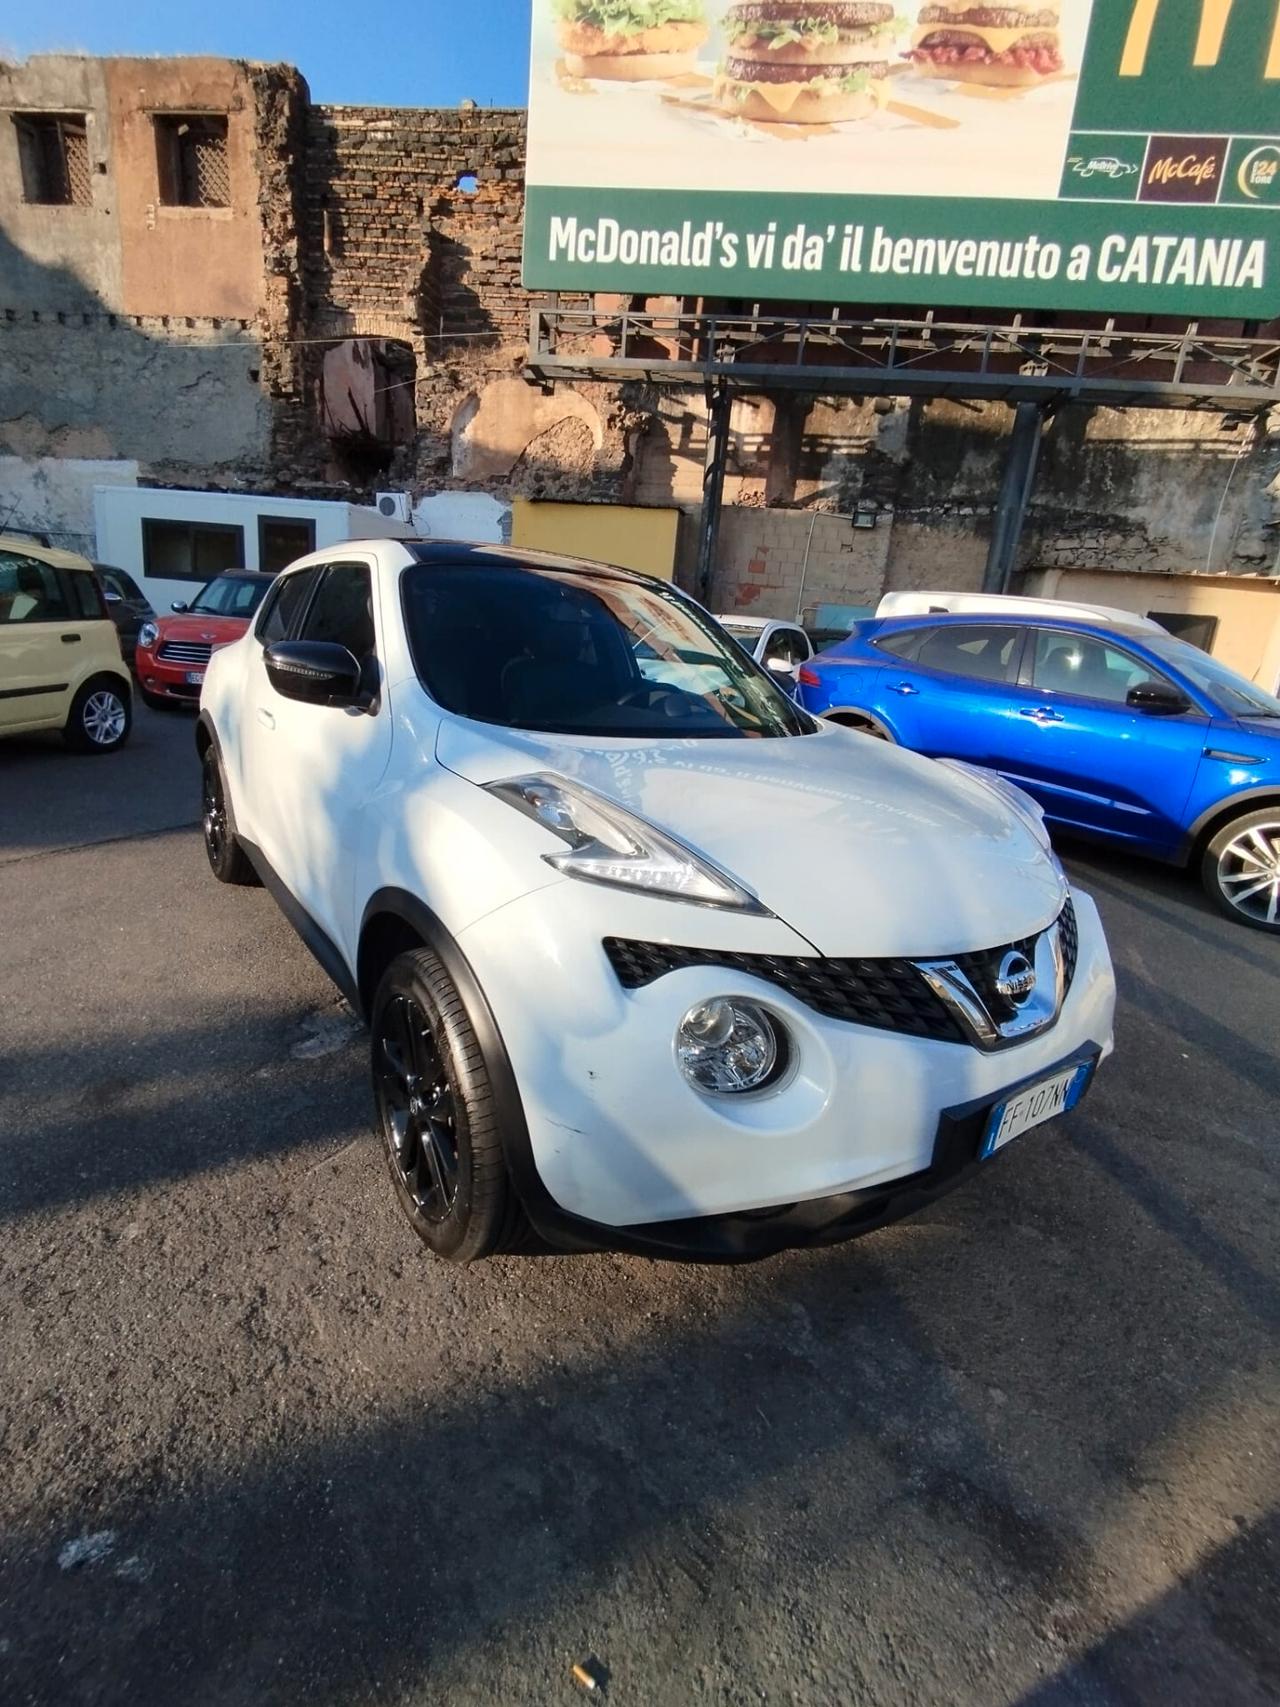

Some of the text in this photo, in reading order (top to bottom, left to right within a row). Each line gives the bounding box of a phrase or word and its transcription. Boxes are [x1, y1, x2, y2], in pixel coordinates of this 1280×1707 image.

[1147, 154, 1216, 185] McCafé
[548, 216, 1265, 288] McDonald's vi da' il benvenuto a CATANIA
